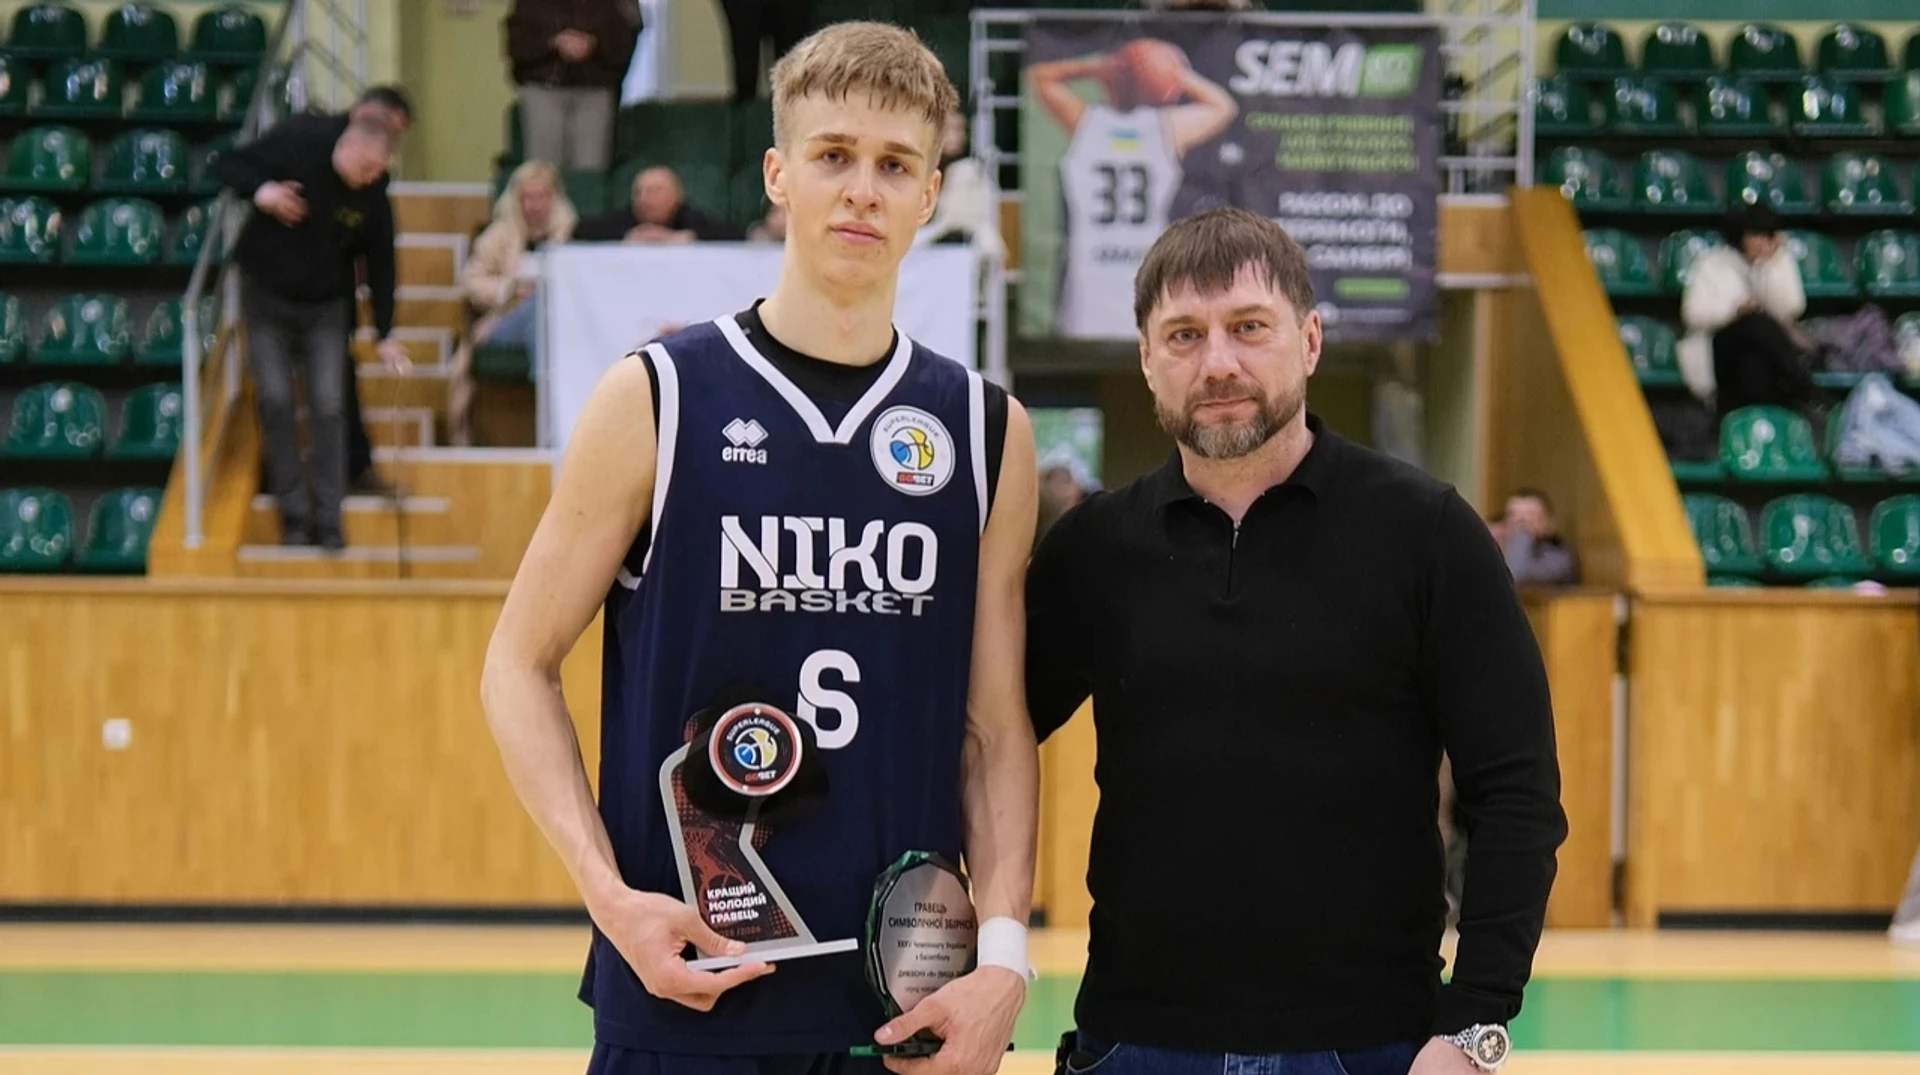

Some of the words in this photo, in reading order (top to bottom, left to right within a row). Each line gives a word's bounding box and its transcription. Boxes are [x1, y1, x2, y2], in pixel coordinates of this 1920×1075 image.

[1092, 164, 1148, 224] 33
[720, 515, 938, 593] NIKO
[720, 589, 934, 616] BASKET
[726, 717, 781, 742] SUPERLEAGUE
[706, 881, 756, 900] КРАЩИЙ
[708, 893, 767, 912] МОЛОДИЙ
[914, 901, 947, 914] ГРАВЕЦЬ
[710, 909, 760, 924] ГРАВЕЦЬ
